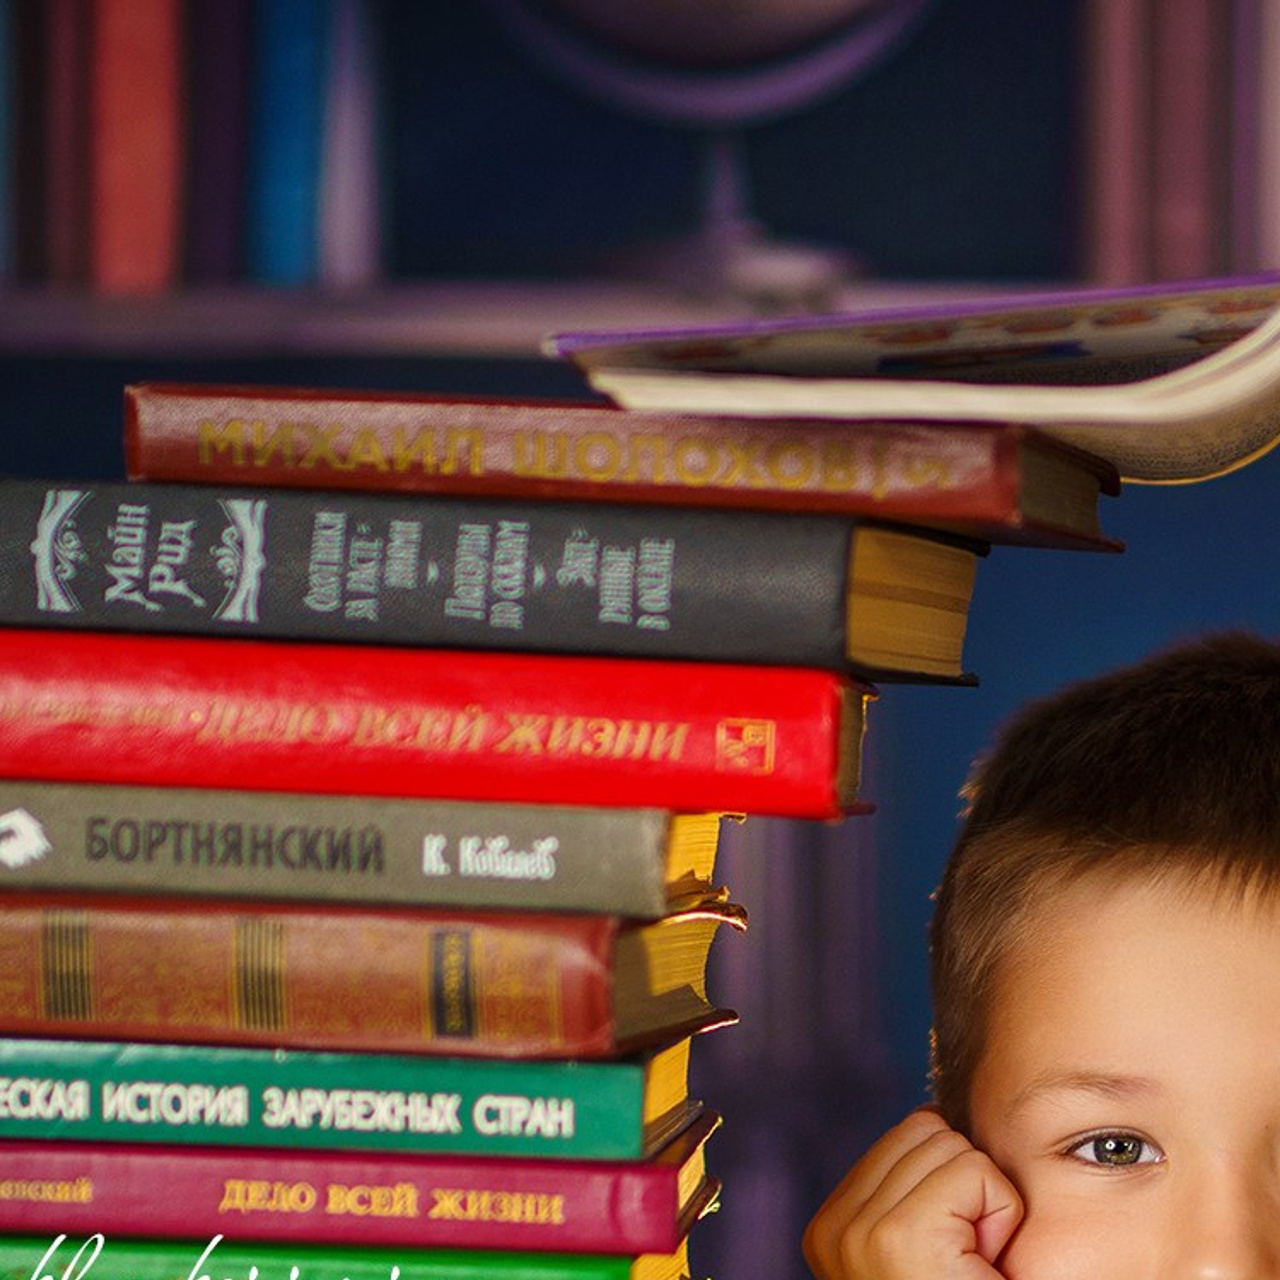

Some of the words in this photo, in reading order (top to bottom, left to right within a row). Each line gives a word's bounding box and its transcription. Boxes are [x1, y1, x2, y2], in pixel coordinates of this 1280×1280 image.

[198, 418, 483, 477] МИХАИЛ
[511, 428, 858, 493] ШОЛОХОВ
[104, 503, 164, 612] Майн
[149, 520, 206, 607] Рид
[494, 713, 690, 762] ЖИЗНИ
[83, 815, 386, 873] БОРТНЯНСКИЙ
[423, 833, 450, 875] К.
[103, 1081, 249, 1127] ИСТОРИЯ
[262, 1087, 460, 1135] ЗАРУБЕЖНЫХ
[472, 1095, 575, 1138] СТРАН
[218, 1178, 316, 1214] ДЕЛО
[326, 1181, 420, 1218] ВСЕЙ
[429, 1189, 564, 1225] ЖИЗНИ
